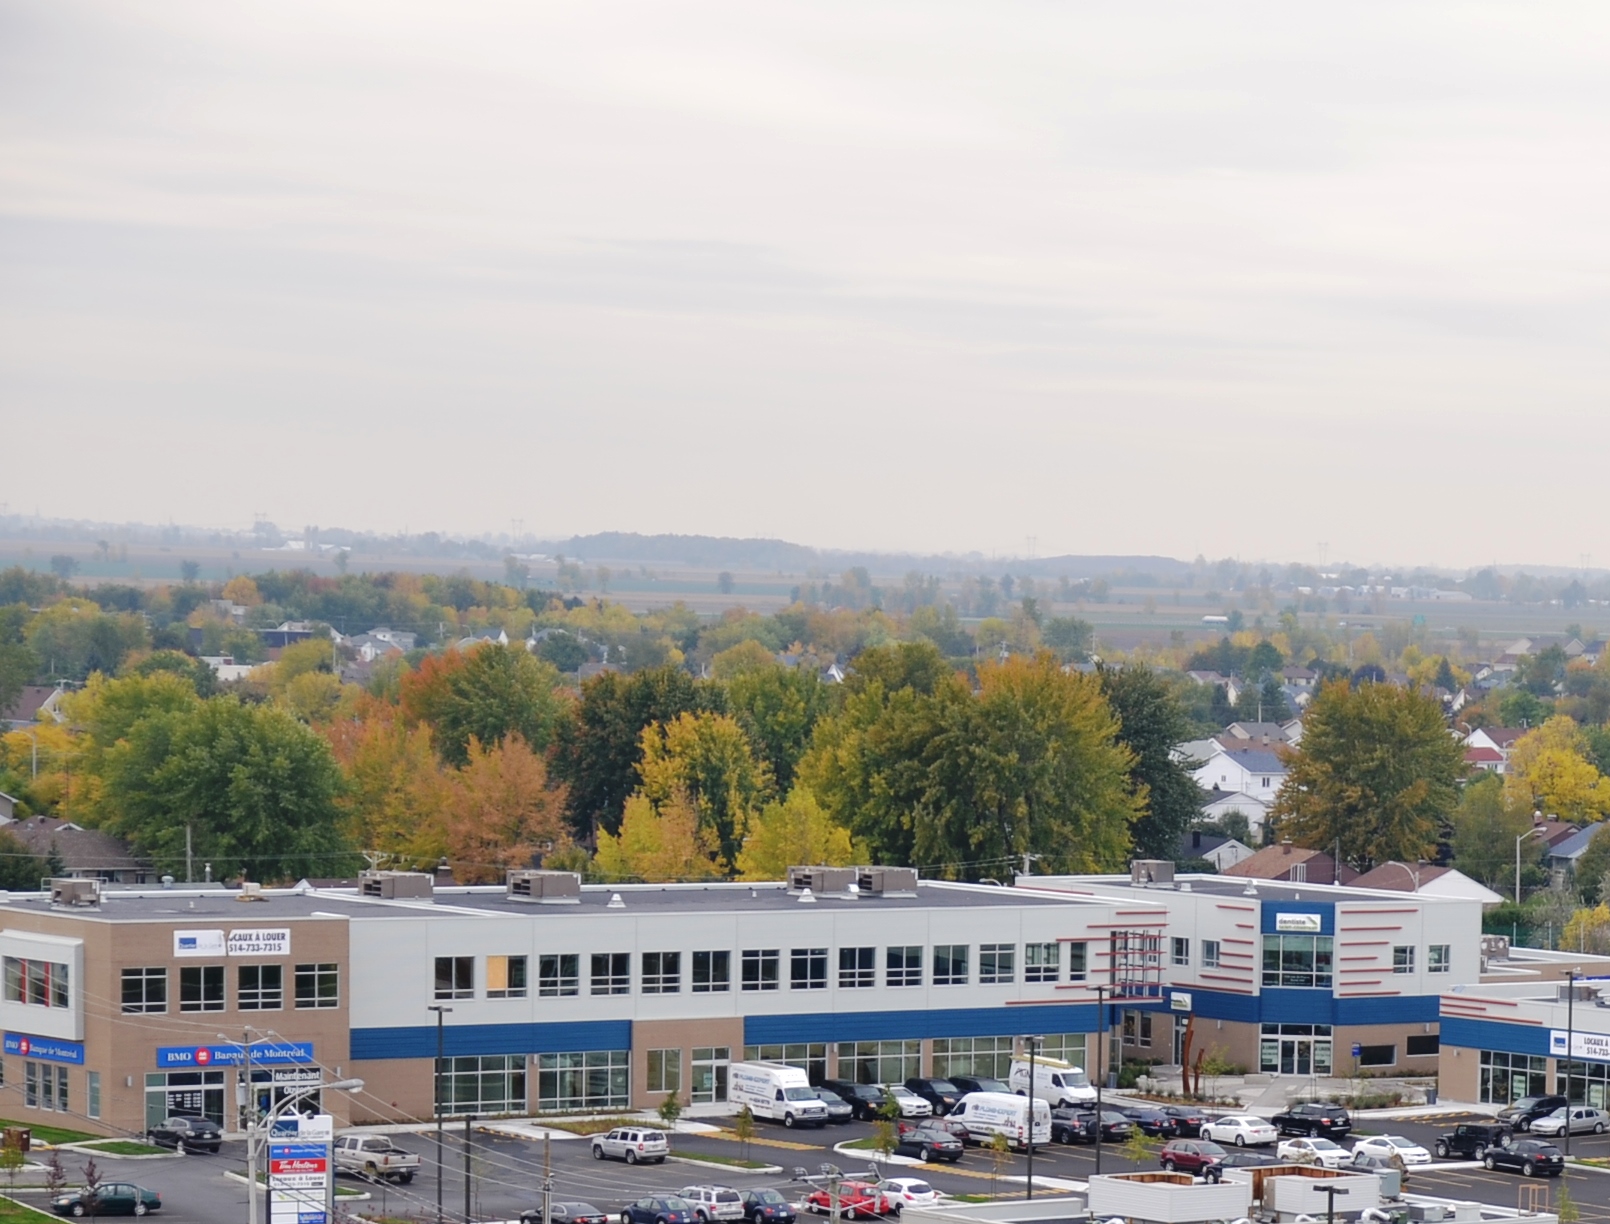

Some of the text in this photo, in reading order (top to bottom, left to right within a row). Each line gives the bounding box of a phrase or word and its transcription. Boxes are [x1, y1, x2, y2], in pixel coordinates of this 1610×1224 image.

[262, 932, 286, 941] LOUER
[229, 942, 282, 953] 514-733-7315
[1583, 1037, 1604, 1047] LOCAUX
[167, 1052, 192, 1062] BMO
[251, 1049, 262, 1058] de
[275, 1071, 321, 1081] Maintenant
